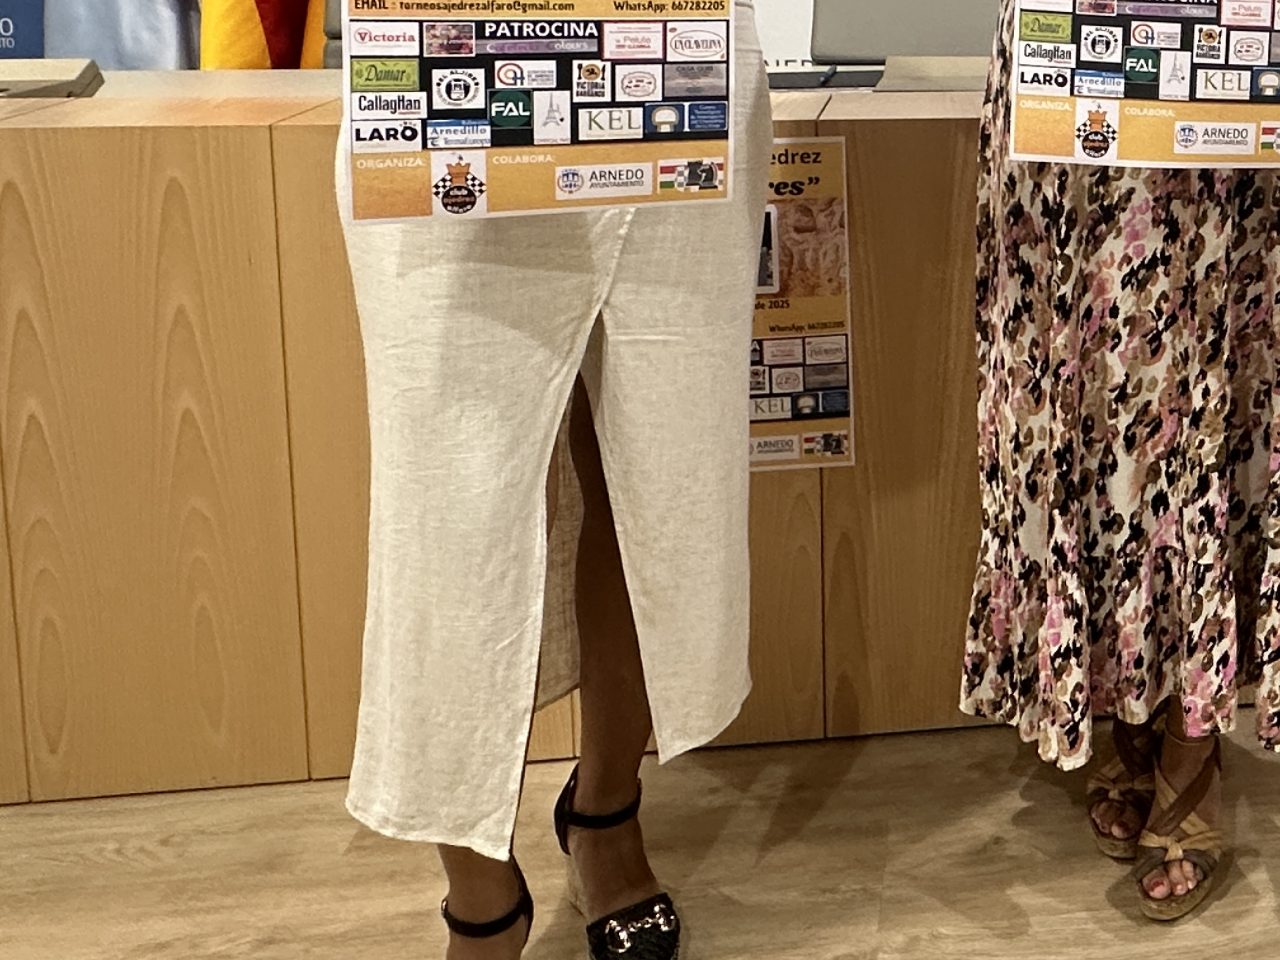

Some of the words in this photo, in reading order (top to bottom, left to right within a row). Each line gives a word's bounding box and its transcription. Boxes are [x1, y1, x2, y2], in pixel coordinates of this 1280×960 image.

[613, 0, 669, 13] WhatsApp:
[671, 1, 725, 11] 667282205
[357, 31, 416, 43] Victoria
[485, 22, 599, 37] PATROCINA
[1126, 57, 1157, 72] FAL
[1020, 71, 1068, 88] LARO
[1203, 71, 1249, 92] KEL
[491, 101, 530, 117] FAL
[586, 109, 641, 131] KEL
[355, 126, 418, 142] LARO
[1202, 127, 1249, 140] ARNEDO
[588, 168, 644, 182] ARNEDO
[767, 299, 790, 310] 2025
